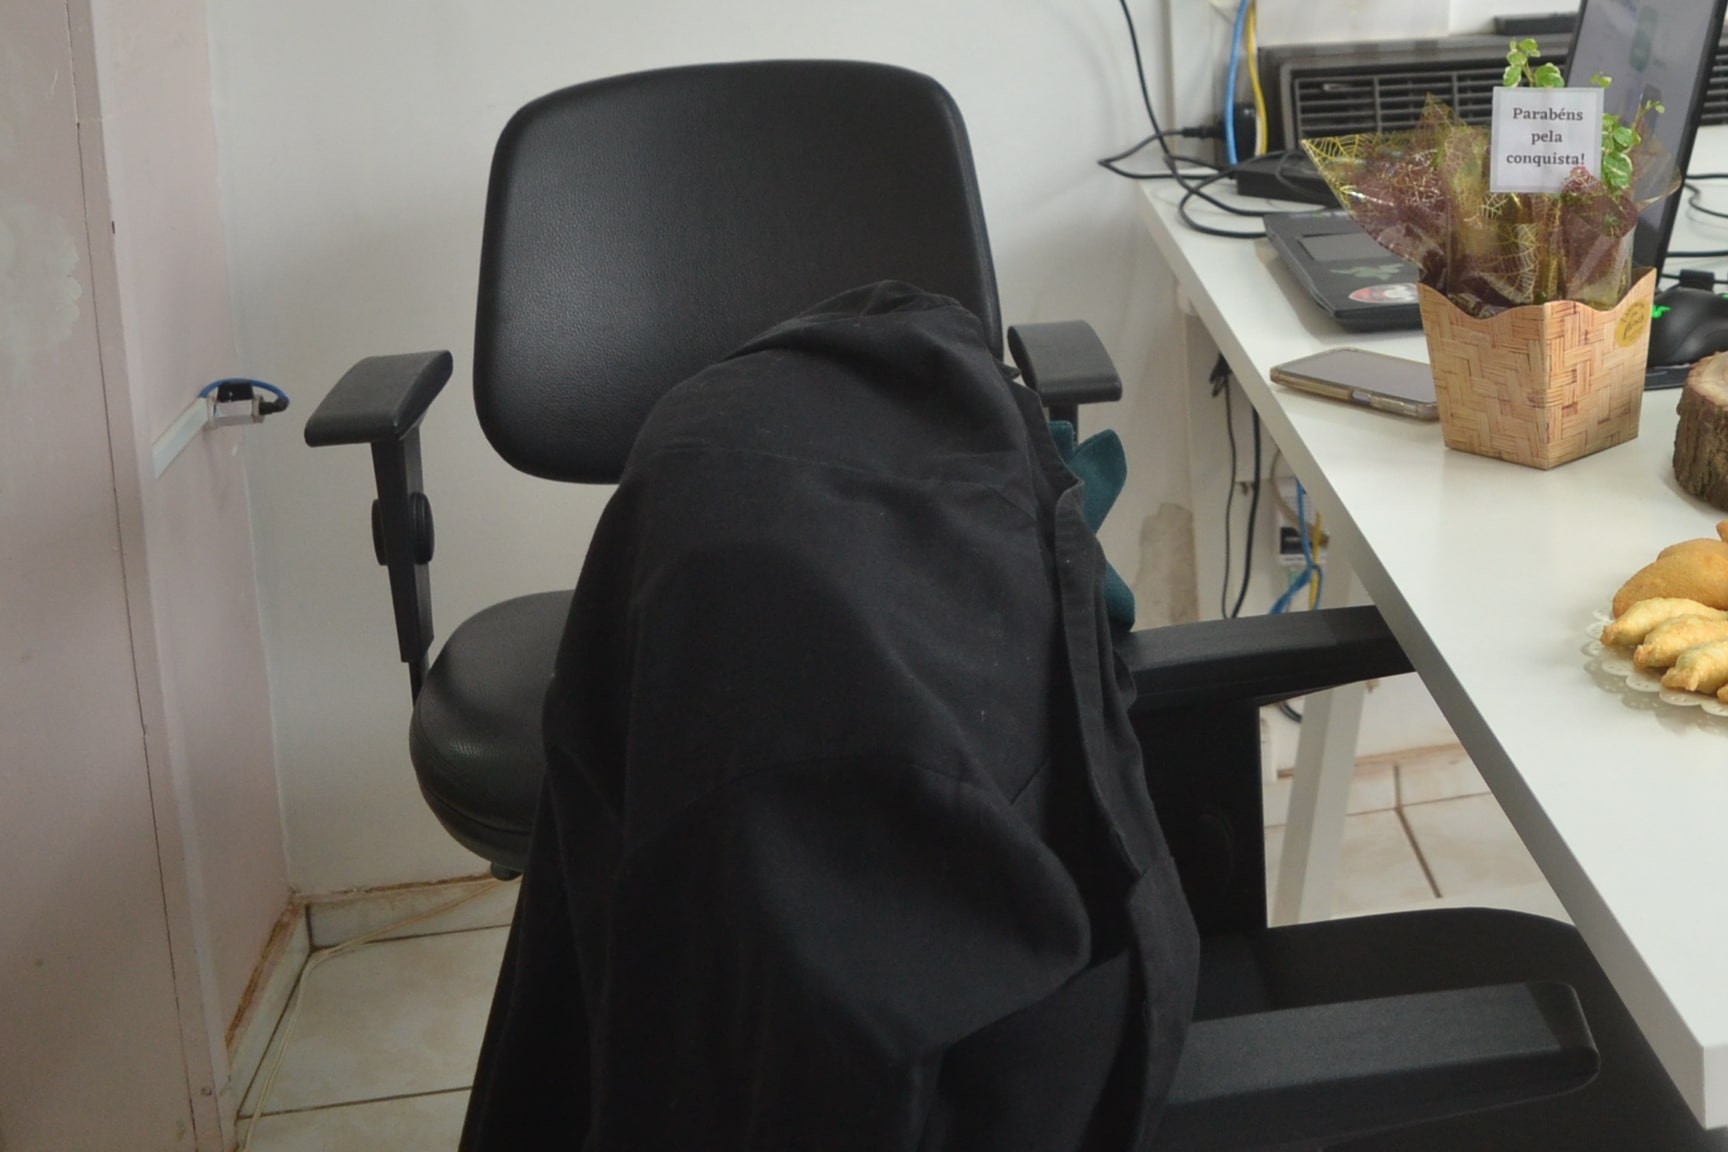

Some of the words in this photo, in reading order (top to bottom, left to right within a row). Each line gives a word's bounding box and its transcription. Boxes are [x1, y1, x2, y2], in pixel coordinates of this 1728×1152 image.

[1512, 107, 1584, 121] Parabéns
[1531, 130, 1563, 145] pela
[1506, 152, 1586, 167] conquista!
